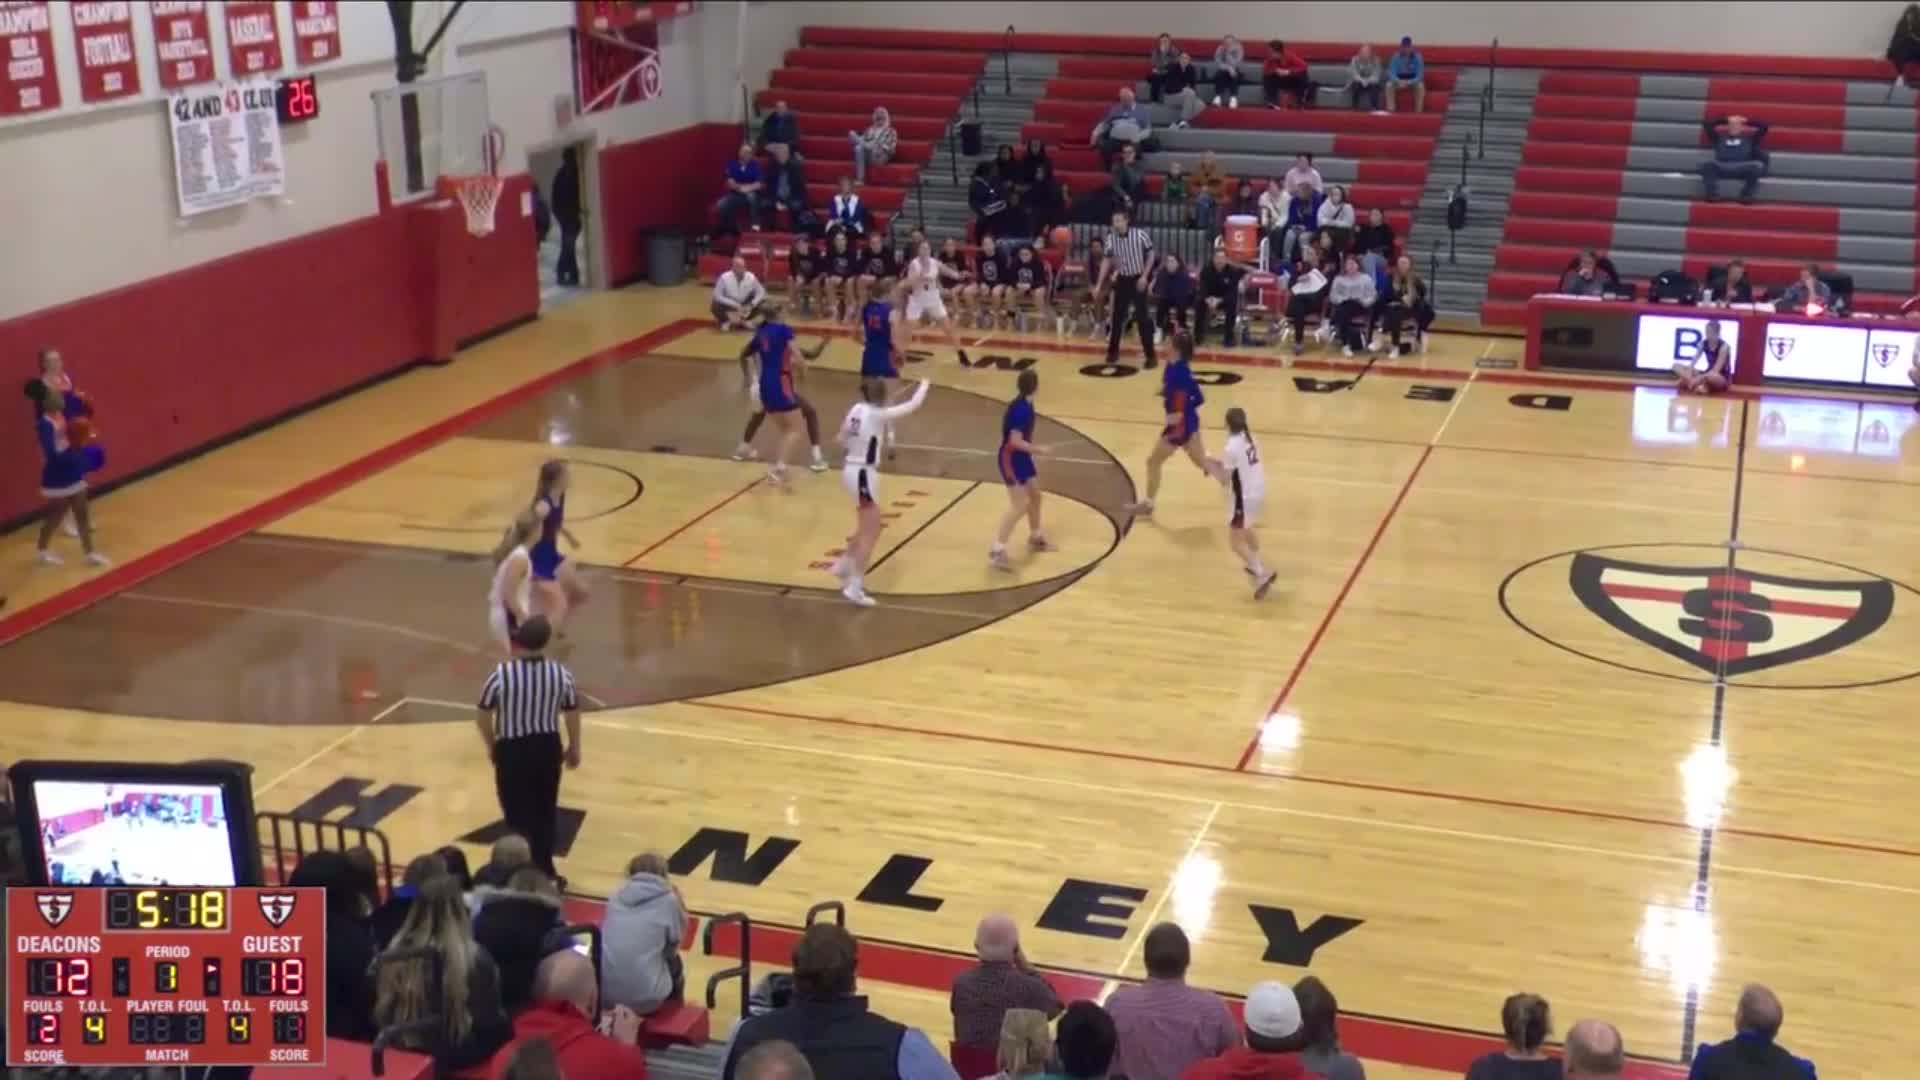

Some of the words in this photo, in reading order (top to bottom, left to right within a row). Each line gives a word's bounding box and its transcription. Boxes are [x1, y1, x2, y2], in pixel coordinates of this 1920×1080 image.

[174, 97, 190, 121] 42
[192, 95, 222, 118] AND
[288, 79, 314, 117] 26
